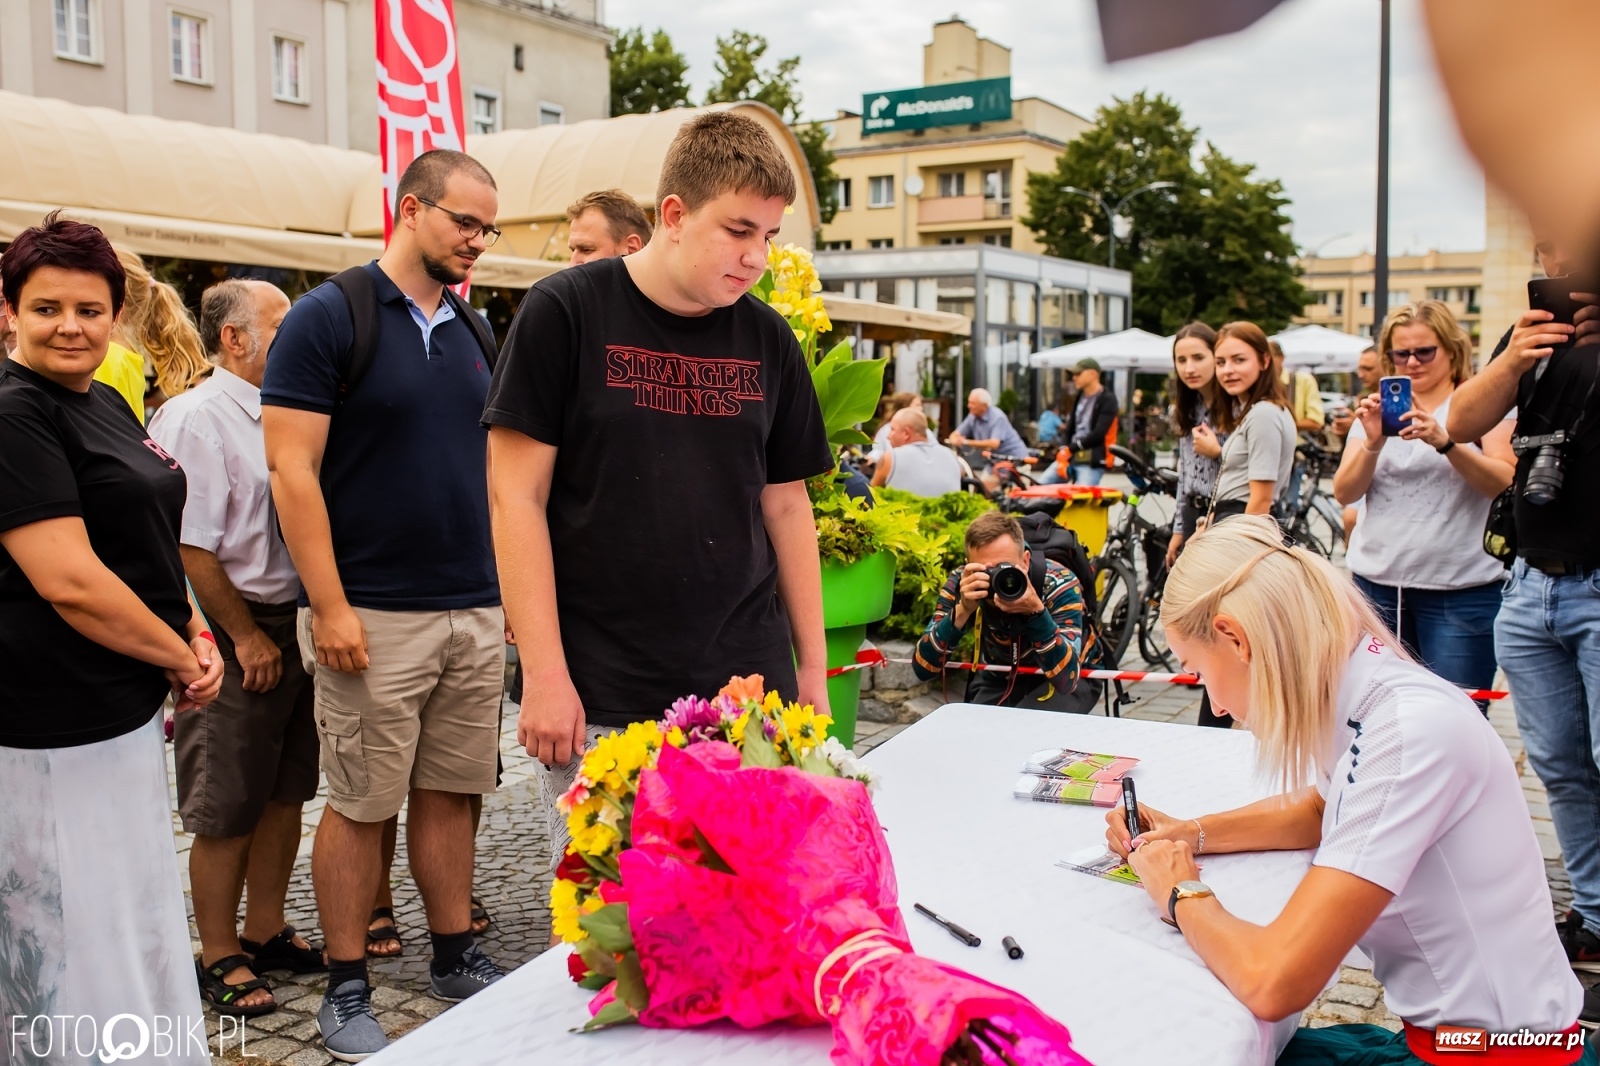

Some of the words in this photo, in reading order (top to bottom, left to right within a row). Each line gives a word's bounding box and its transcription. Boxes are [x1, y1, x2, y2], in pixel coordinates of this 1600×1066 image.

[896, 96, 974, 117] McDonald's
[606, 349, 764, 396] STRANGER
[631, 380, 742, 416] THINGS
